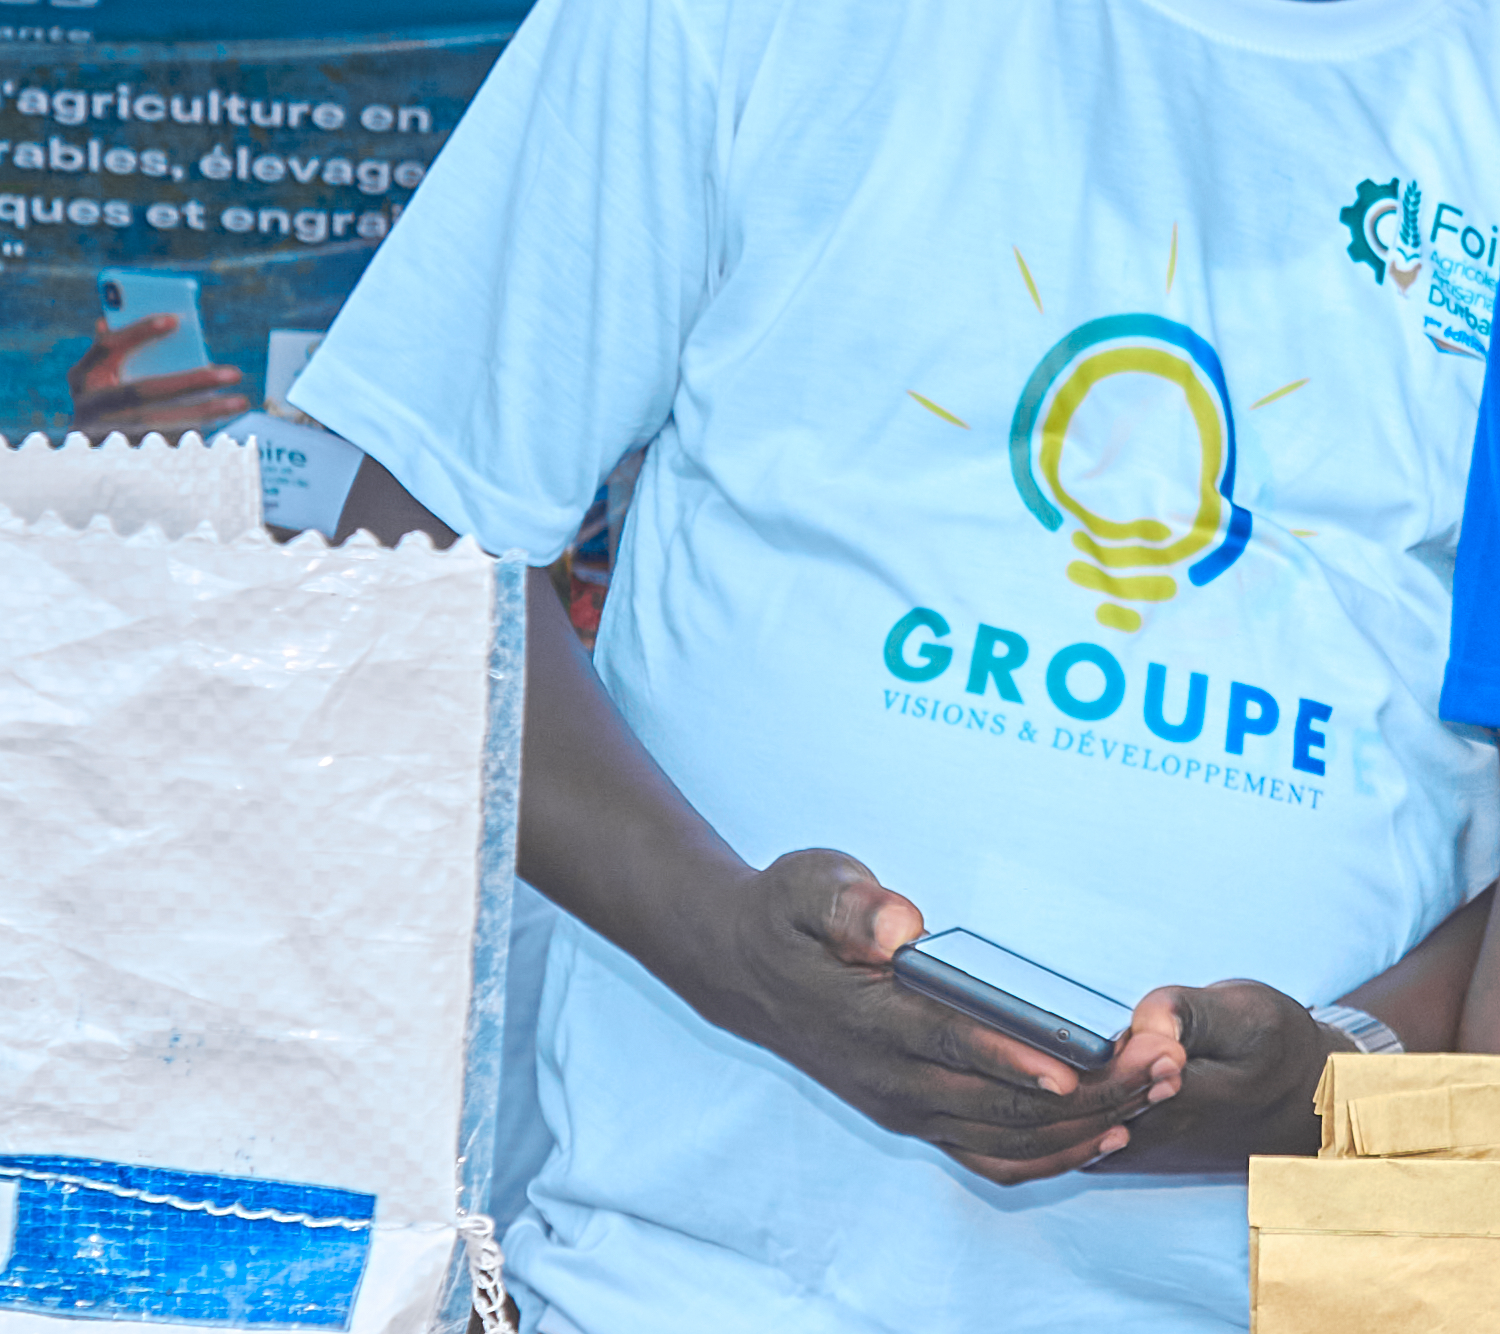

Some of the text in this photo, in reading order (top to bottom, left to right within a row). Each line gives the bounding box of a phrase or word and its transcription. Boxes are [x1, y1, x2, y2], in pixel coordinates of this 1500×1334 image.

[360, 103, 433, 134] en
[200, 143, 425, 196] élevage
[146, 199, 206, 231] et
[883, 606, 1334, 777] GROUPE
[882, 688, 1325, 811] VISIONS & DÉVELOPPEMENT
